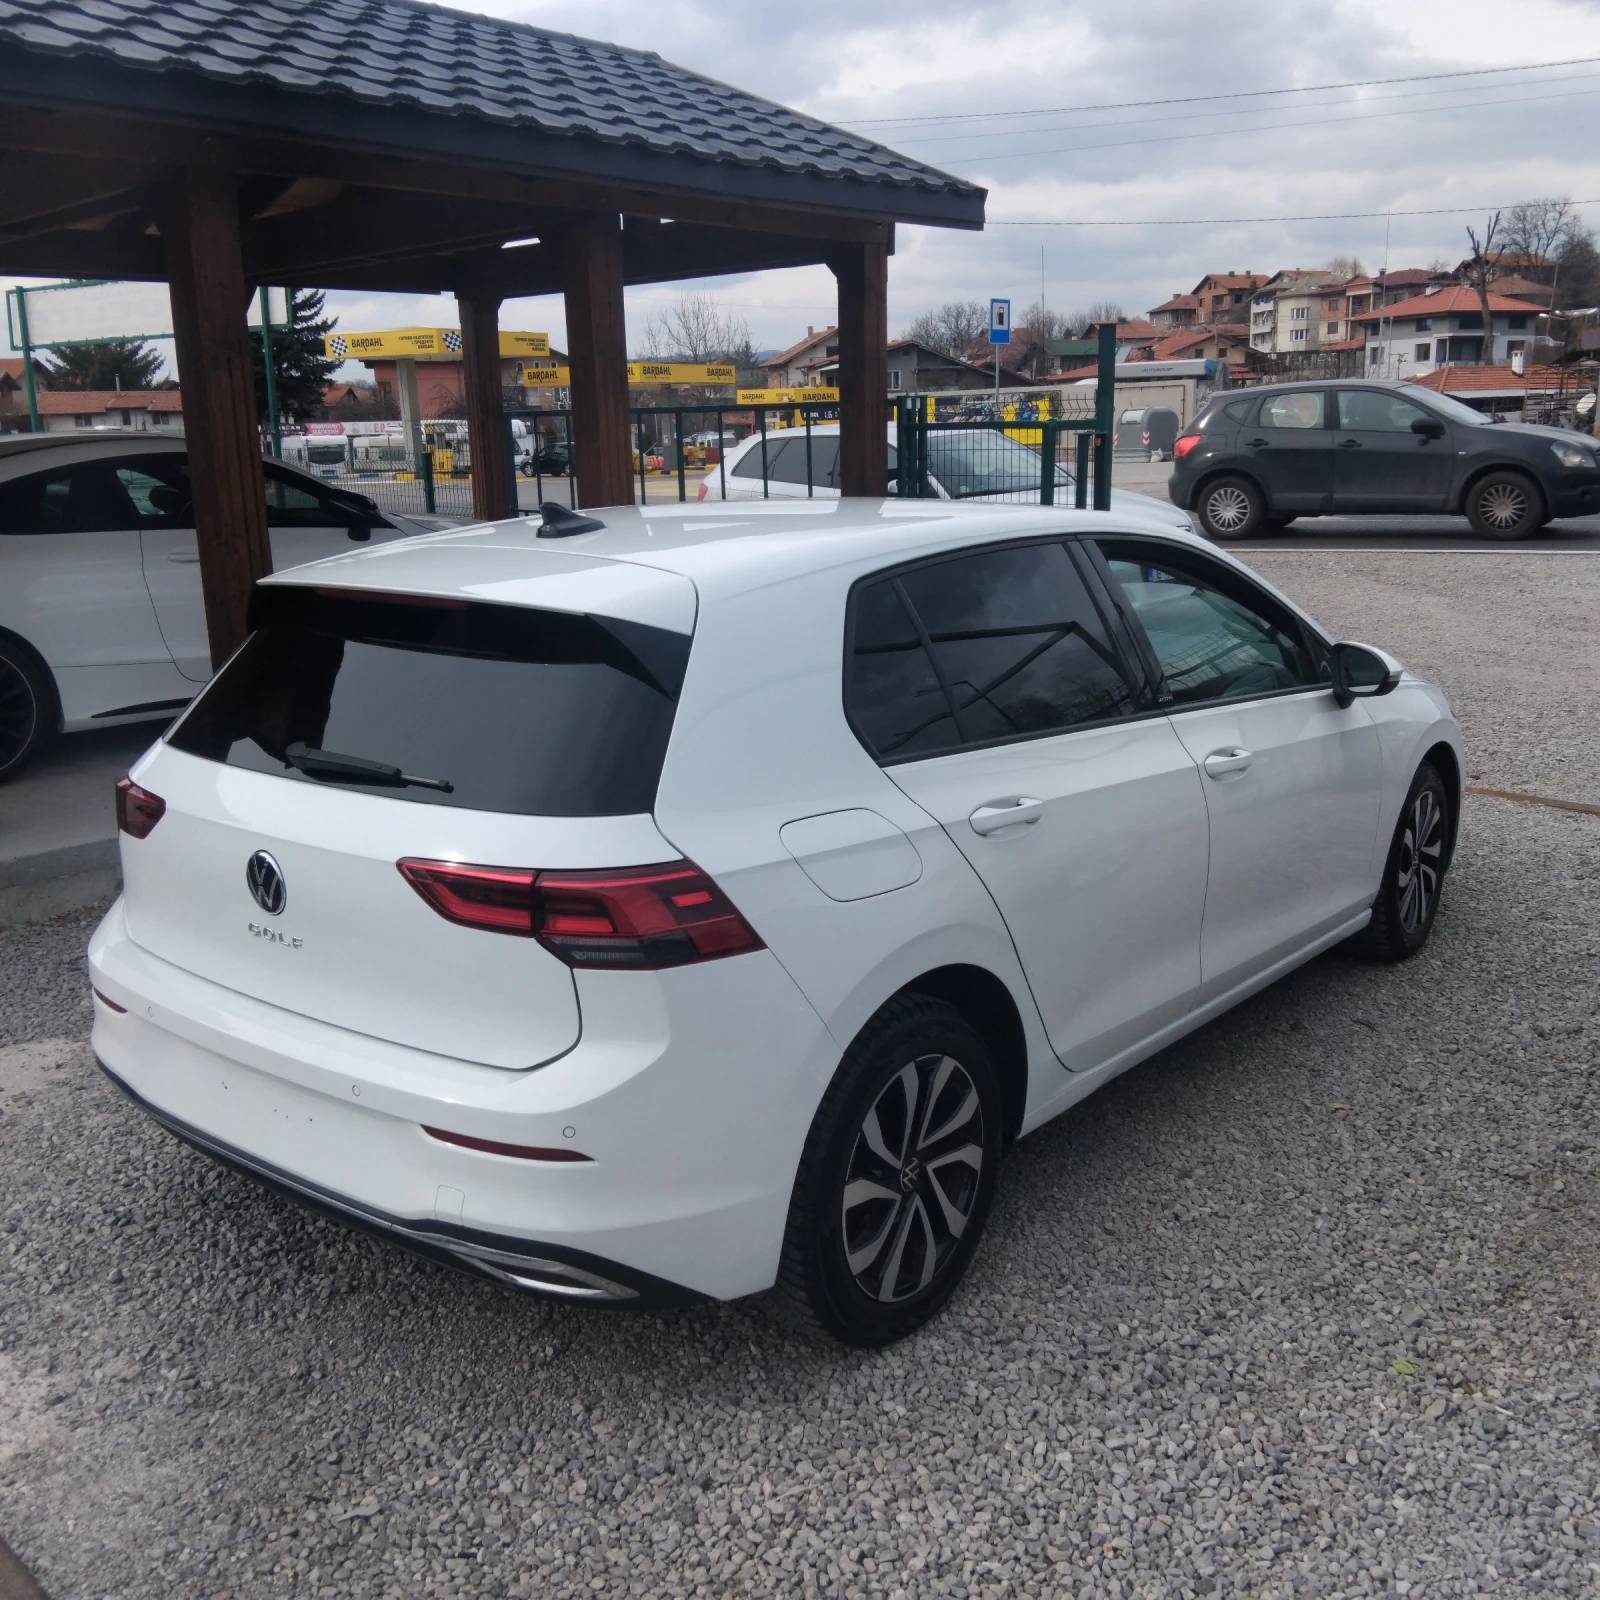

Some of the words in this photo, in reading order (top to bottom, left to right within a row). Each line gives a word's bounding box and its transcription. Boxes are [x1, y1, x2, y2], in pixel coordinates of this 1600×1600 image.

[351, 337, 384, 350] BARDAHL
[527, 371, 559, 383] BARDAHL
[642, 366, 672, 378] BARDAHL
[706, 368, 733, 380] BARDAHL
[741, 393, 765, 402] BARDAHL
[802, 392, 836, 402] BARDAHL
[247, 922, 303, 949] GOLF
